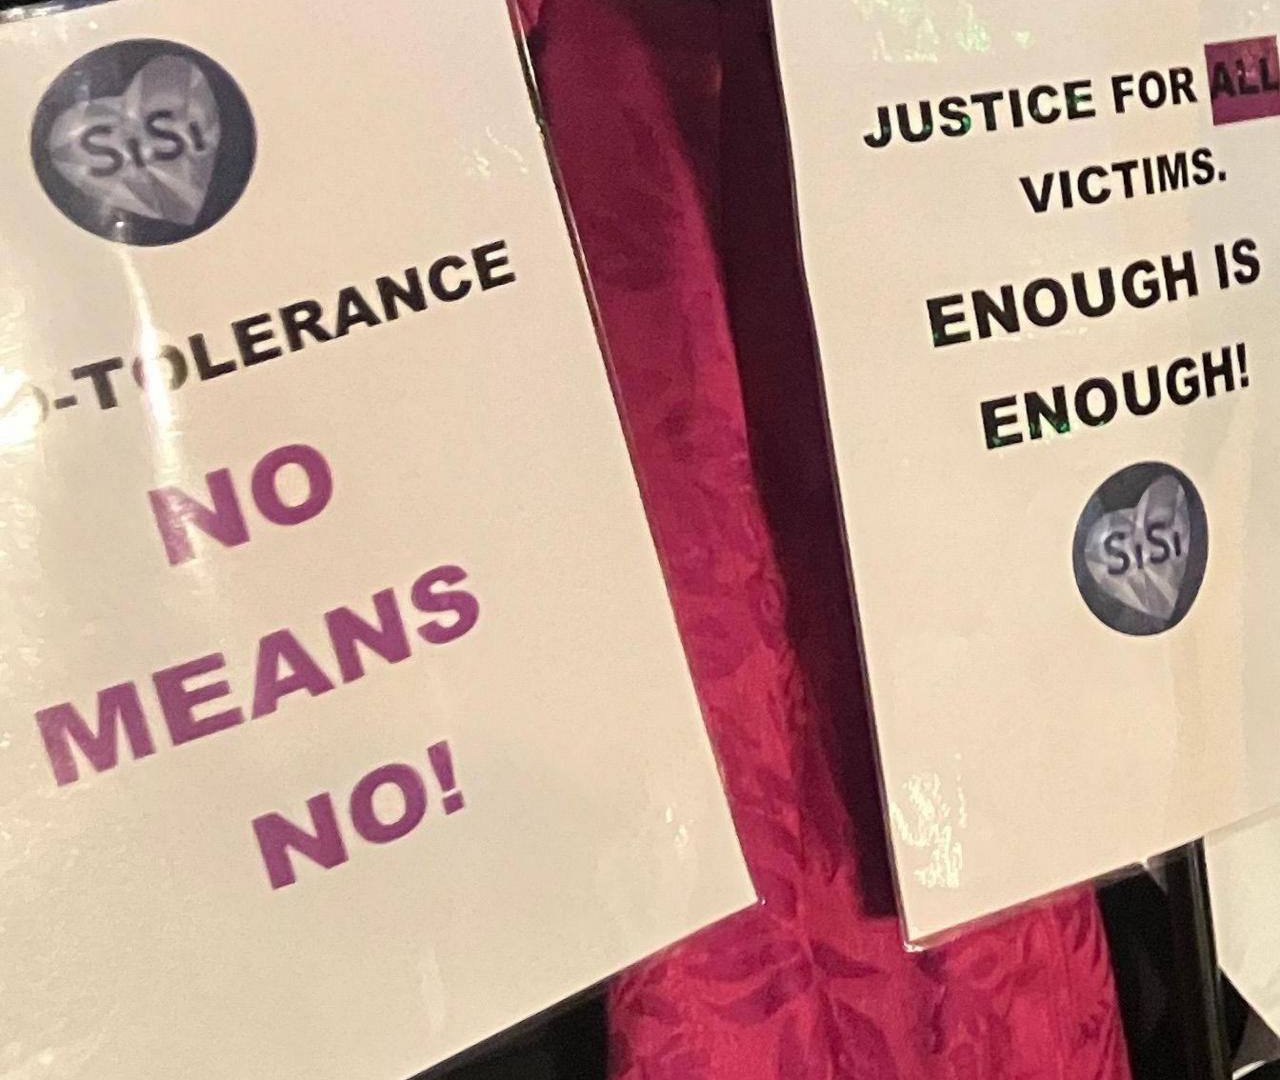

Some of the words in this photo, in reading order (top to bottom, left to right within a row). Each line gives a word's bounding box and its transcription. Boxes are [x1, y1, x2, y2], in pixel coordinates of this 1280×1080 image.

[863, 77, 1096, 149] JUSTICE
[1112, 64, 1198, 112] FOR
[1019, 147, 1227, 215] VICTIMS.
[927, 253, 1198, 348] ENOUGH
[1214, 237, 1262, 292] IS
[980, 343, 1250, 450] ENOUGH!
[148, 443, 335, 566] NO
[36, 565, 481, 787] MEANS
[251, 741, 466, 890] NO!
